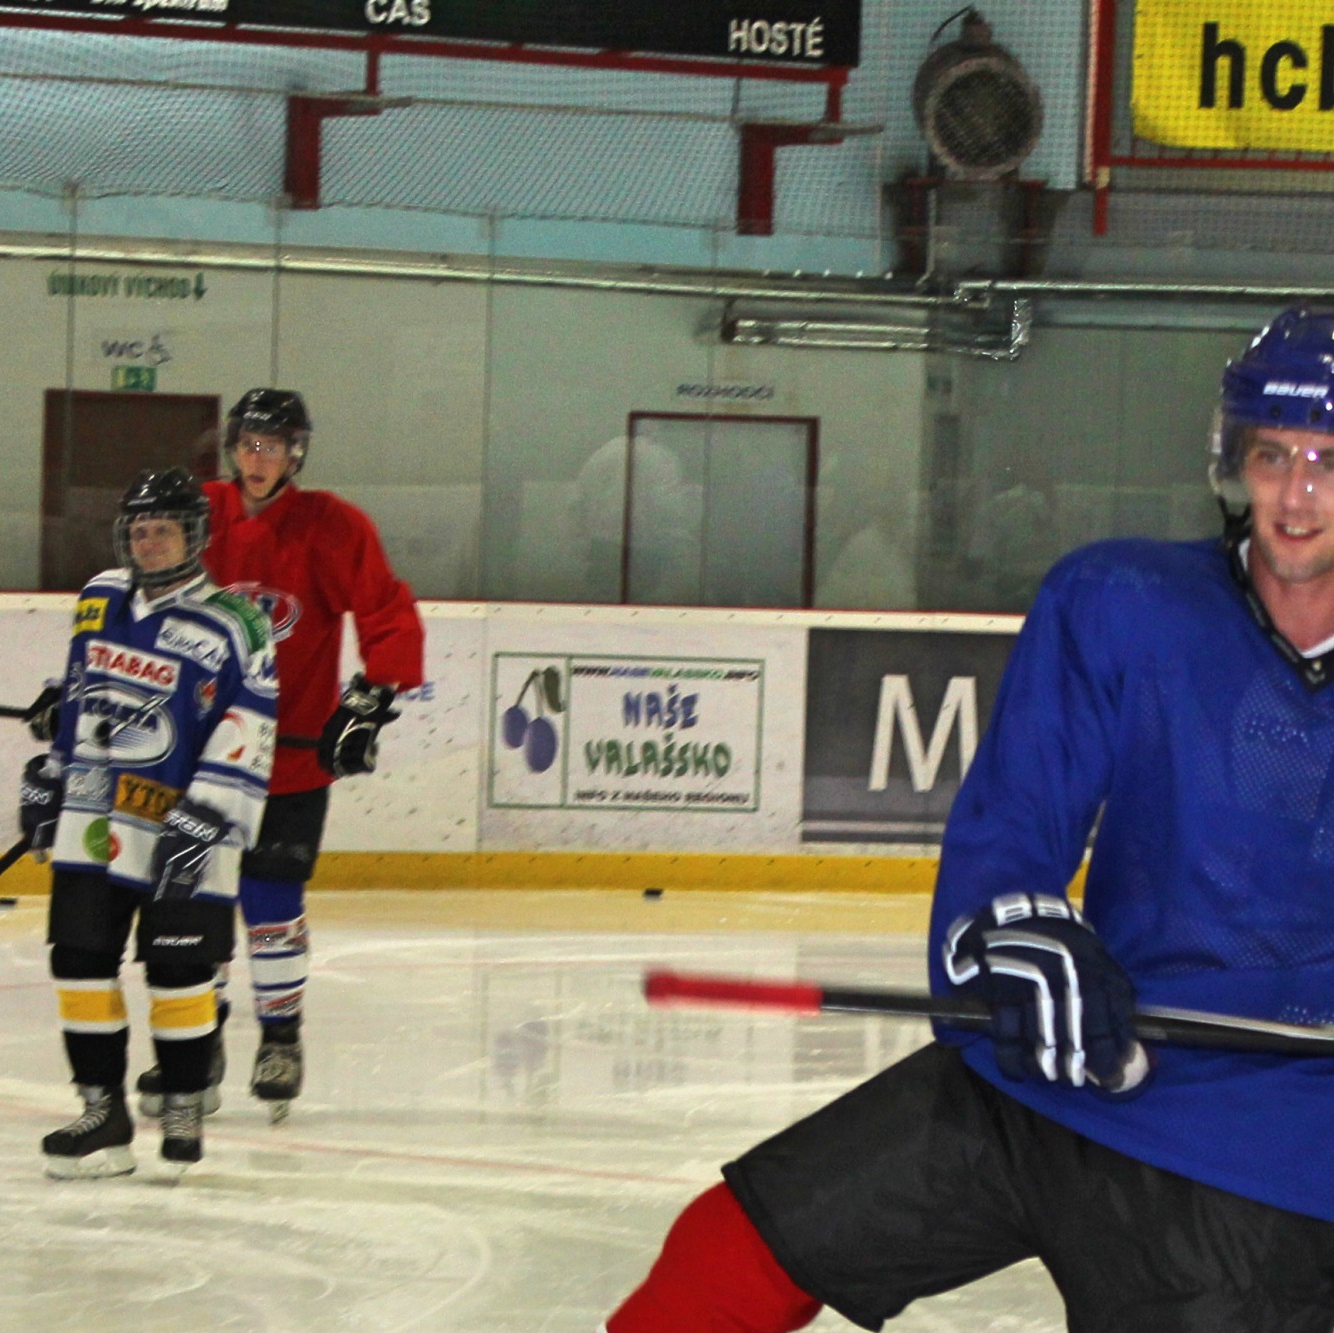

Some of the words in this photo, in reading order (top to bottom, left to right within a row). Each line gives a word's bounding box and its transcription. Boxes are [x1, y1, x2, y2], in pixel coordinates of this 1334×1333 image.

[728, 16, 825, 57] HOSTÉ
[100, 340, 144, 359] WC
[1263, 381, 1330, 399] BAUER
